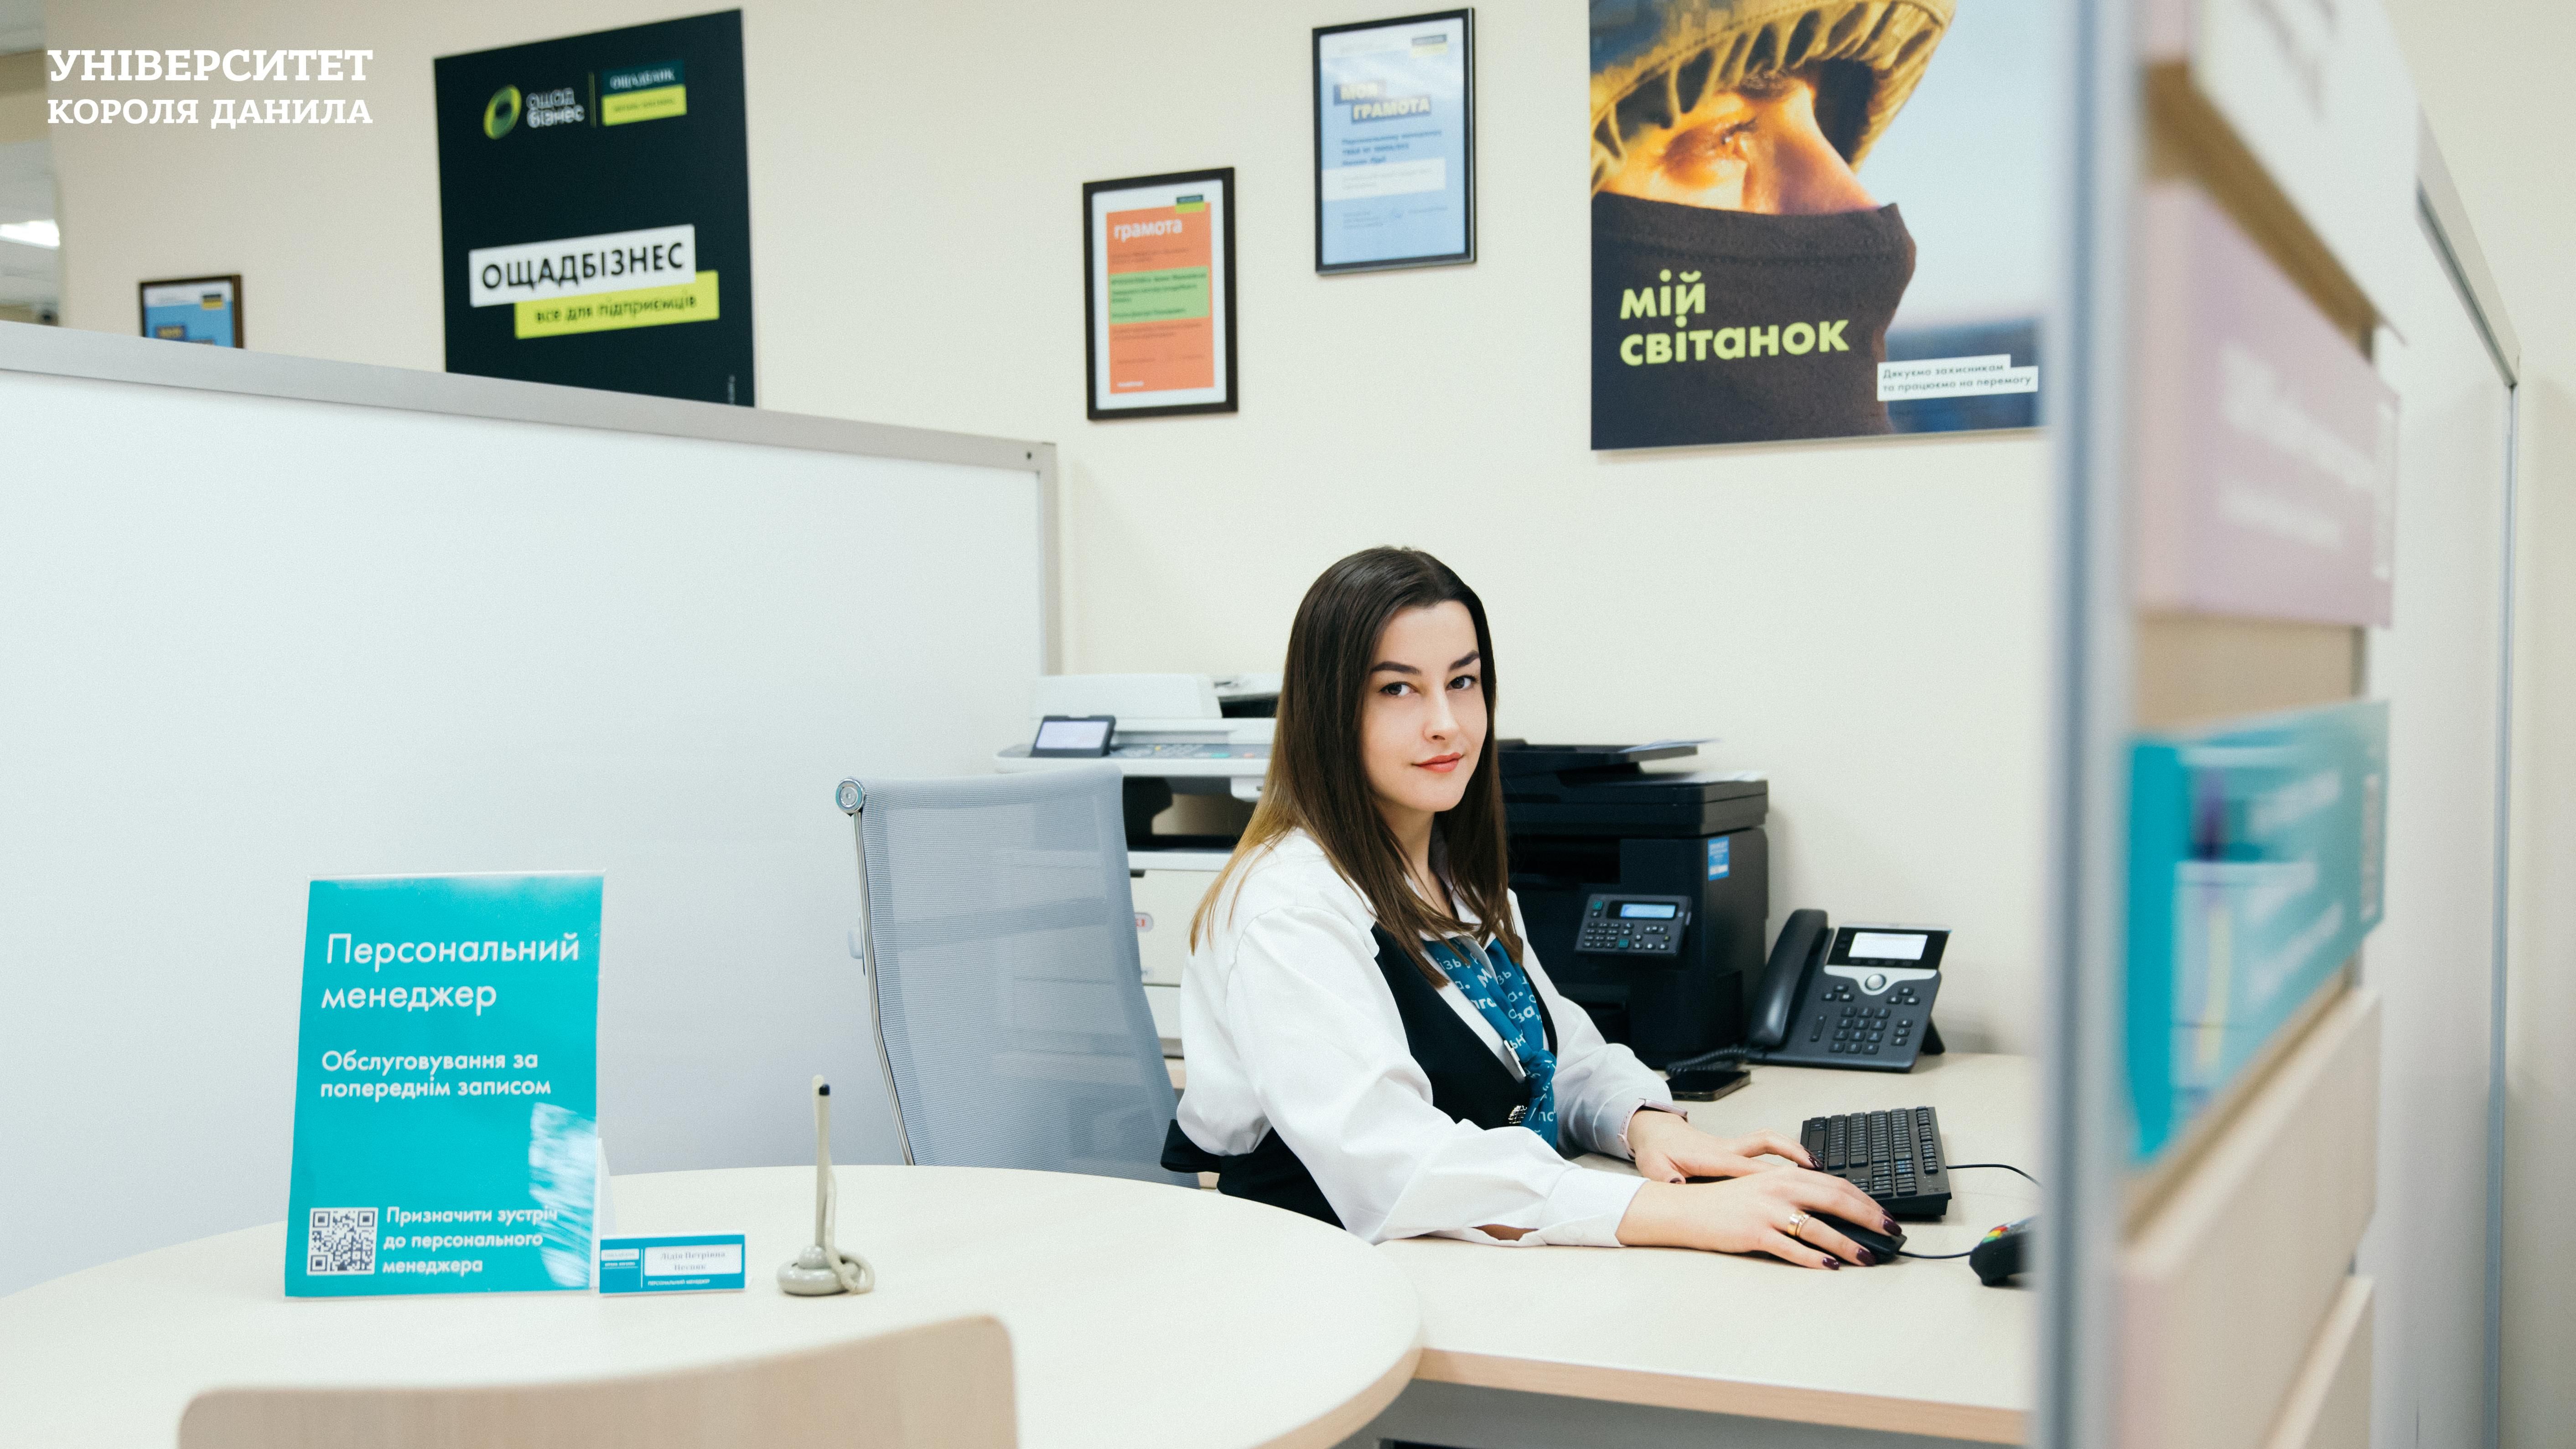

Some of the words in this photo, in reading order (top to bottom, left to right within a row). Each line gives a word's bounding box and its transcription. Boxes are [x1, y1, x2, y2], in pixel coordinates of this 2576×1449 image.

[1353, 98, 1430, 120] ГРАМОТА
[1114, 219, 1182, 243] грамота
[482, 242, 684, 291] ОЩАДБІЗНЕС
[1620, 268, 1706, 319] мій
[1620, 315, 1850, 367] світанок
[1883, 369, 1931, 379] Дякуємо
[1936, 364, 2004, 375] захисникам
[1898, 382, 1955, 393] працюємо
[1977, 376, 2032, 387] перемогу
[327, 931, 580, 972] Персональний
[321, 985, 497, 1017] менеджер
[322, 1049, 505, 1076] Обслуговування
[513, 1054, 538, 1069] за
[321, 1076, 450, 1102] попереднім
[457, 1080, 551, 1096] записом
[386, 1206, 492, 1227] Призначити
[497, 1205, 558, 1228] зустріч
[383, 1234, 406, 1250] до
[411, 1232, 544, 1252] персонального
[382, 1259, 483, 1278] менеджера
